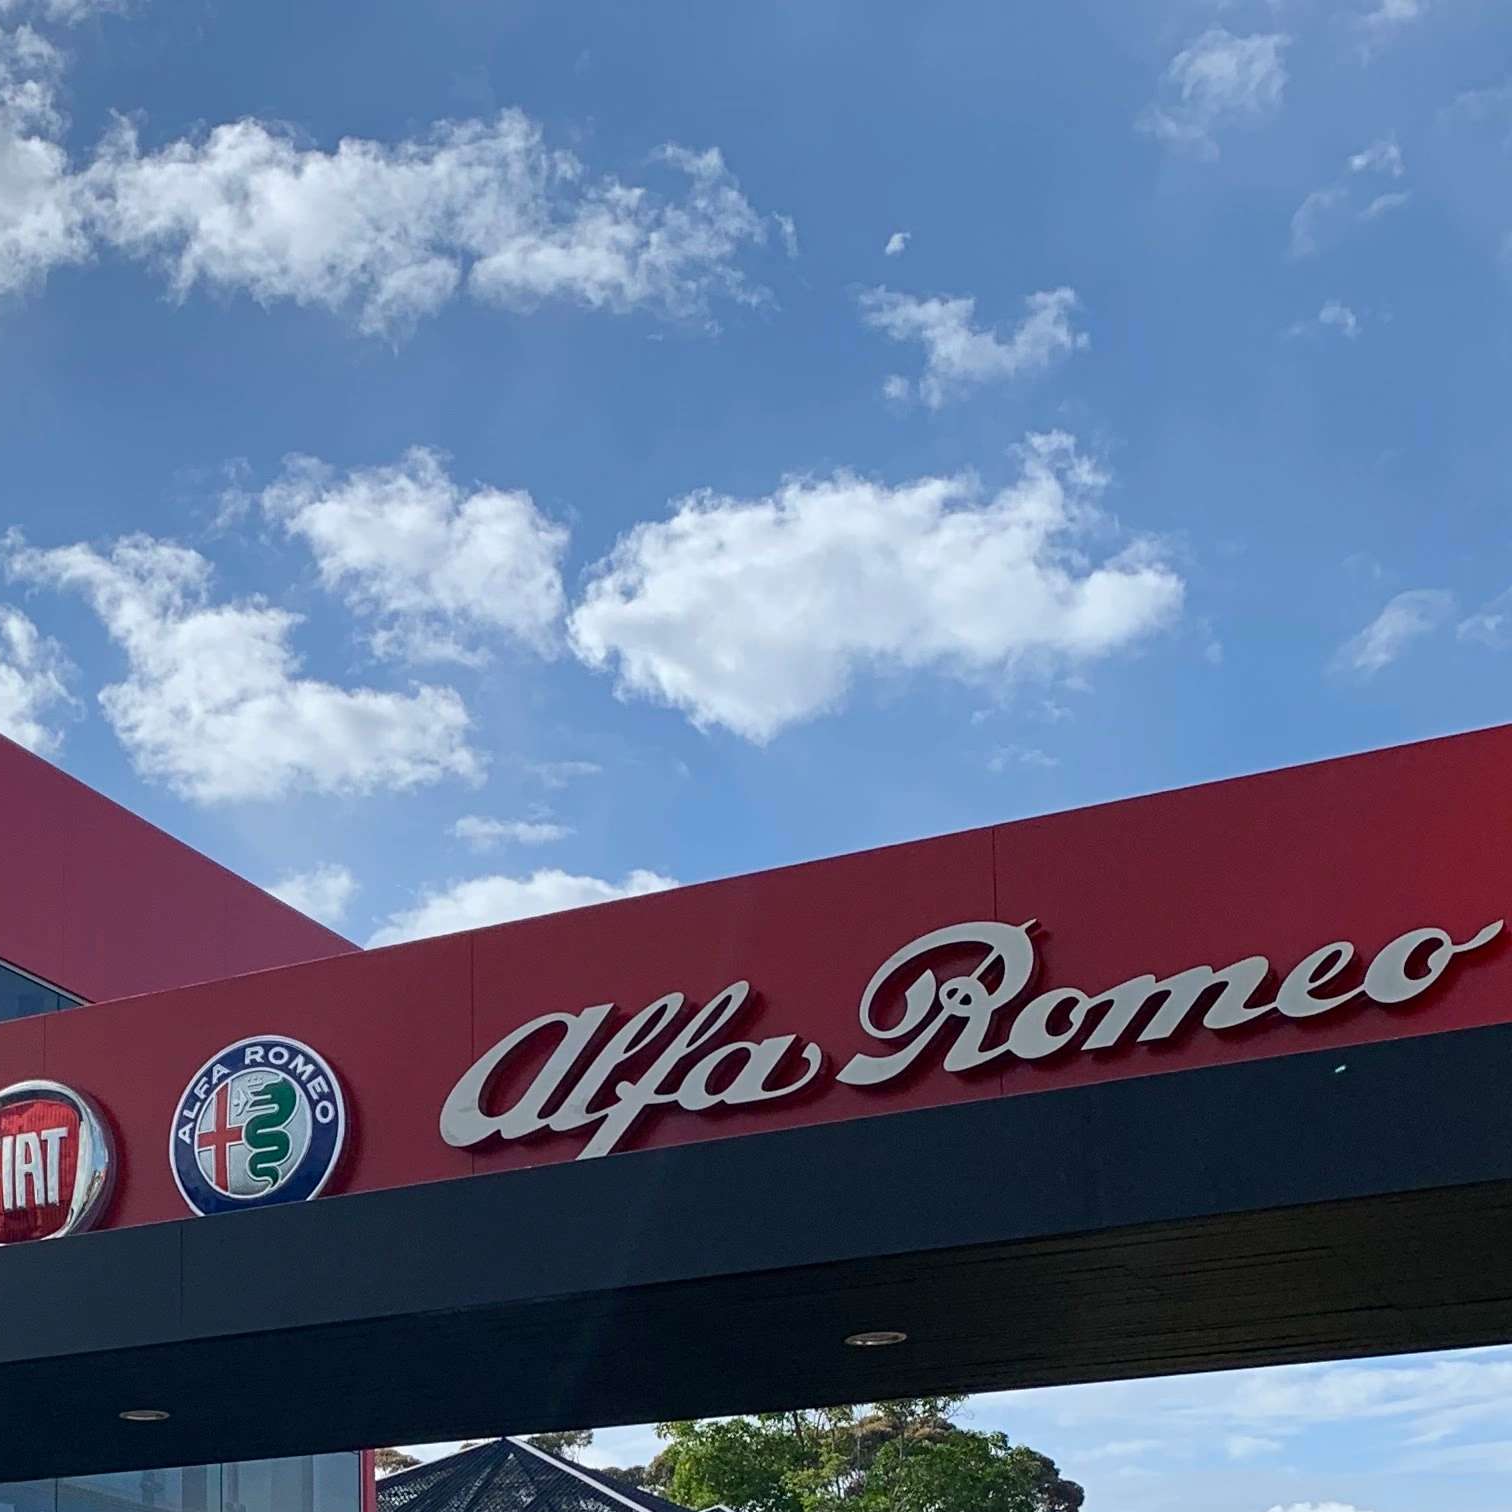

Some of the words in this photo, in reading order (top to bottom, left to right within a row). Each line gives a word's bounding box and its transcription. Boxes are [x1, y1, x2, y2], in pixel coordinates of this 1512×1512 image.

[177, 1063, 232, 1144] ALFA
[245, 1046, 335, 1124] ROMEO
[439, 979, 822, 1159] Alfa
[837, 918, 1505, 1085] Romeo
